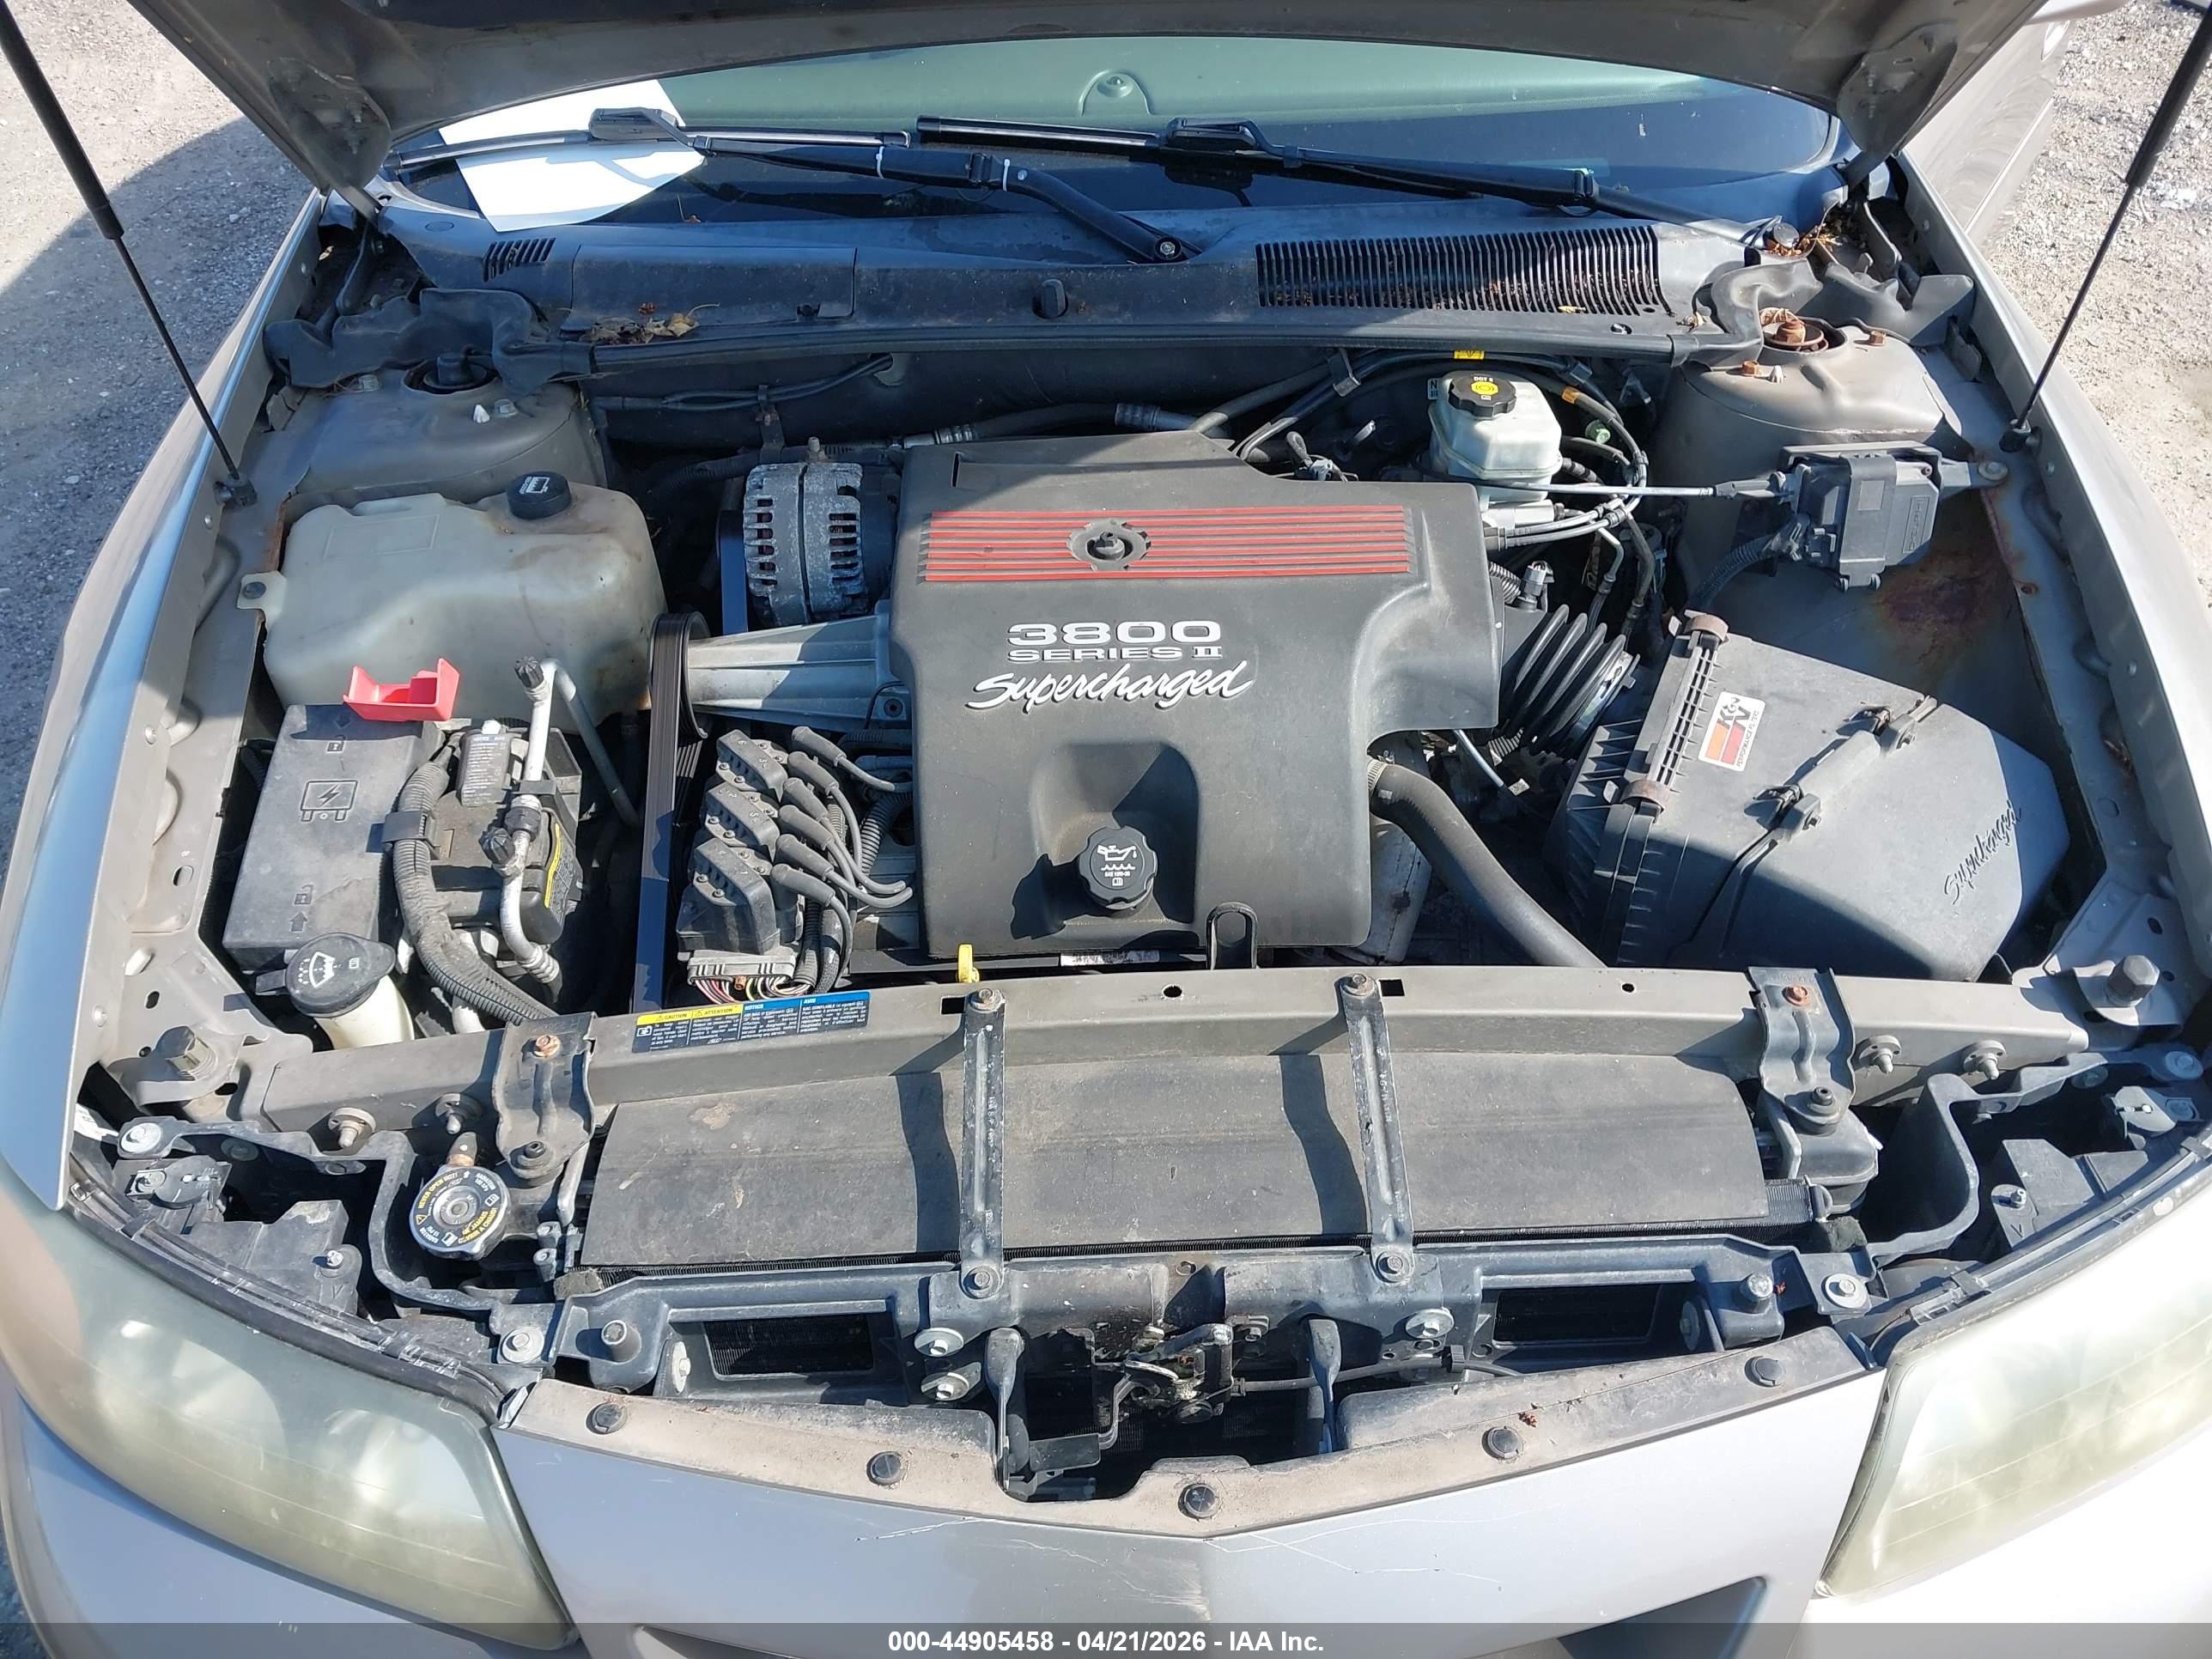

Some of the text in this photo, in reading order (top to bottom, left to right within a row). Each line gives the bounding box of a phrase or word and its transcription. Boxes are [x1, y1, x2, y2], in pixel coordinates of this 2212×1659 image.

[1007, 620, 1221, 646] 3800
[1007, 646, 1223, 662] SERIES II
[964, 660, 1255, 714] Supercharged
[1717, 697, 1751, 730] K&N
[417, 1191, 432, 1209] NEVER
[428, 1178, 445, 1192] OPEN
[471, 1211, 489, 1231] JAMAIS
